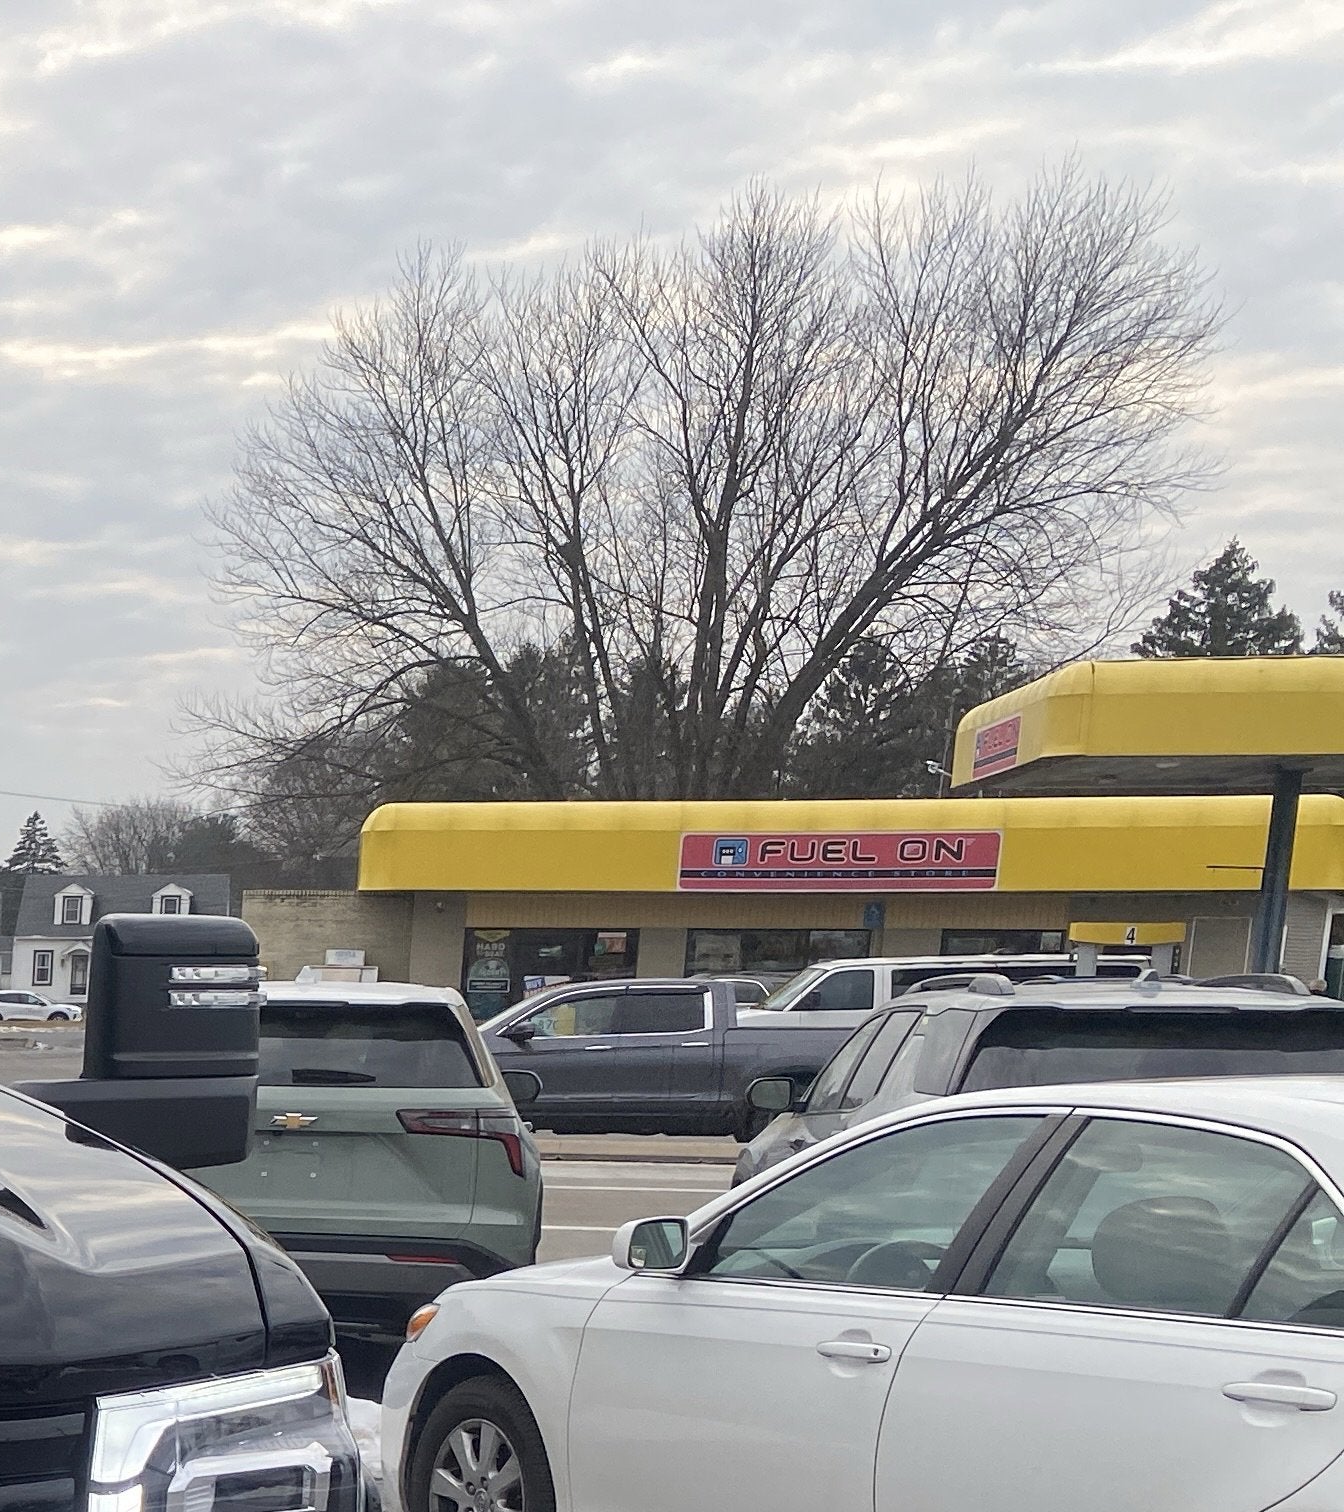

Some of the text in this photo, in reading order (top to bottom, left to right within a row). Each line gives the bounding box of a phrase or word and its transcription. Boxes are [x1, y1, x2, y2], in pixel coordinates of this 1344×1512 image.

[759, 838, 967, 863] FUEL ON
[700, 868, 969, 878] CONVENIENCE STORE
[1127, 927, 1136, 944] 4
